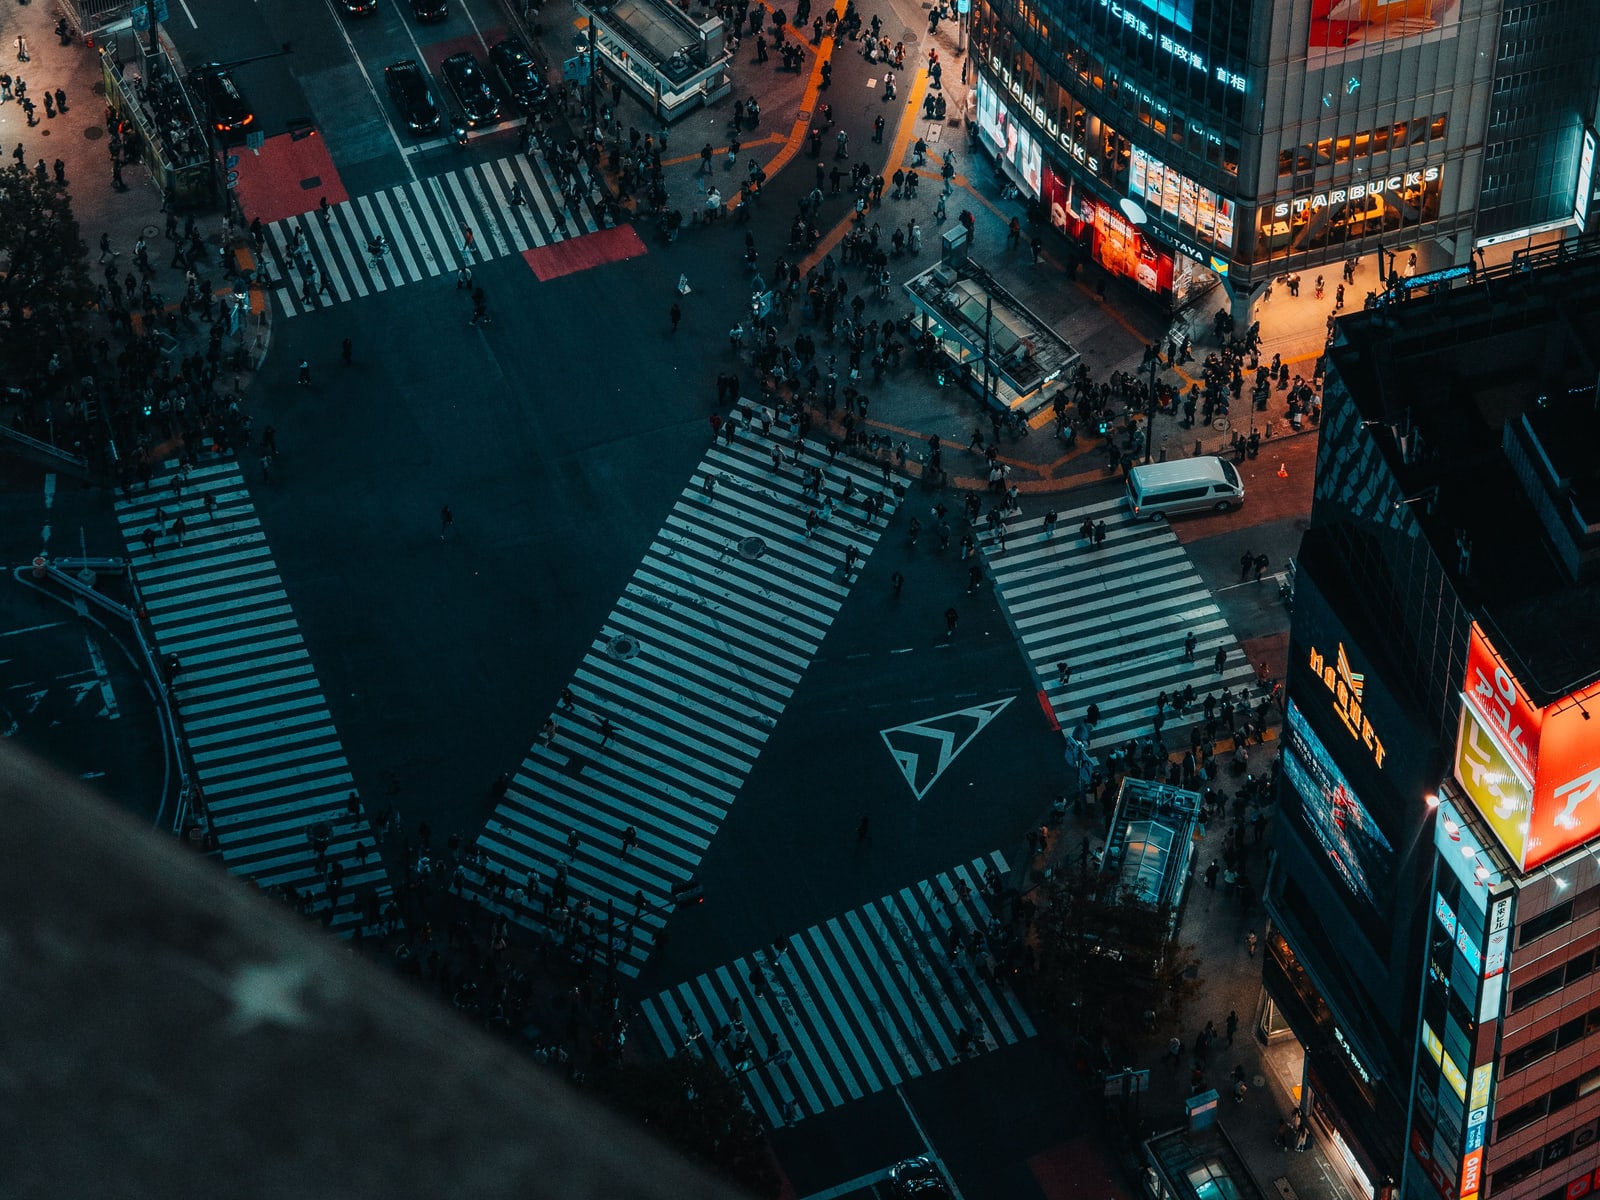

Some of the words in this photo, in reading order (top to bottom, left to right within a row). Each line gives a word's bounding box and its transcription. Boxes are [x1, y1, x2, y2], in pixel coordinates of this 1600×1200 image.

[992, 54, 1099, 170] STARBUCKS
[1274, 167, 1440, 218] STARBUCKS
[1152, 224, 1204, 262] TSUTAYA
